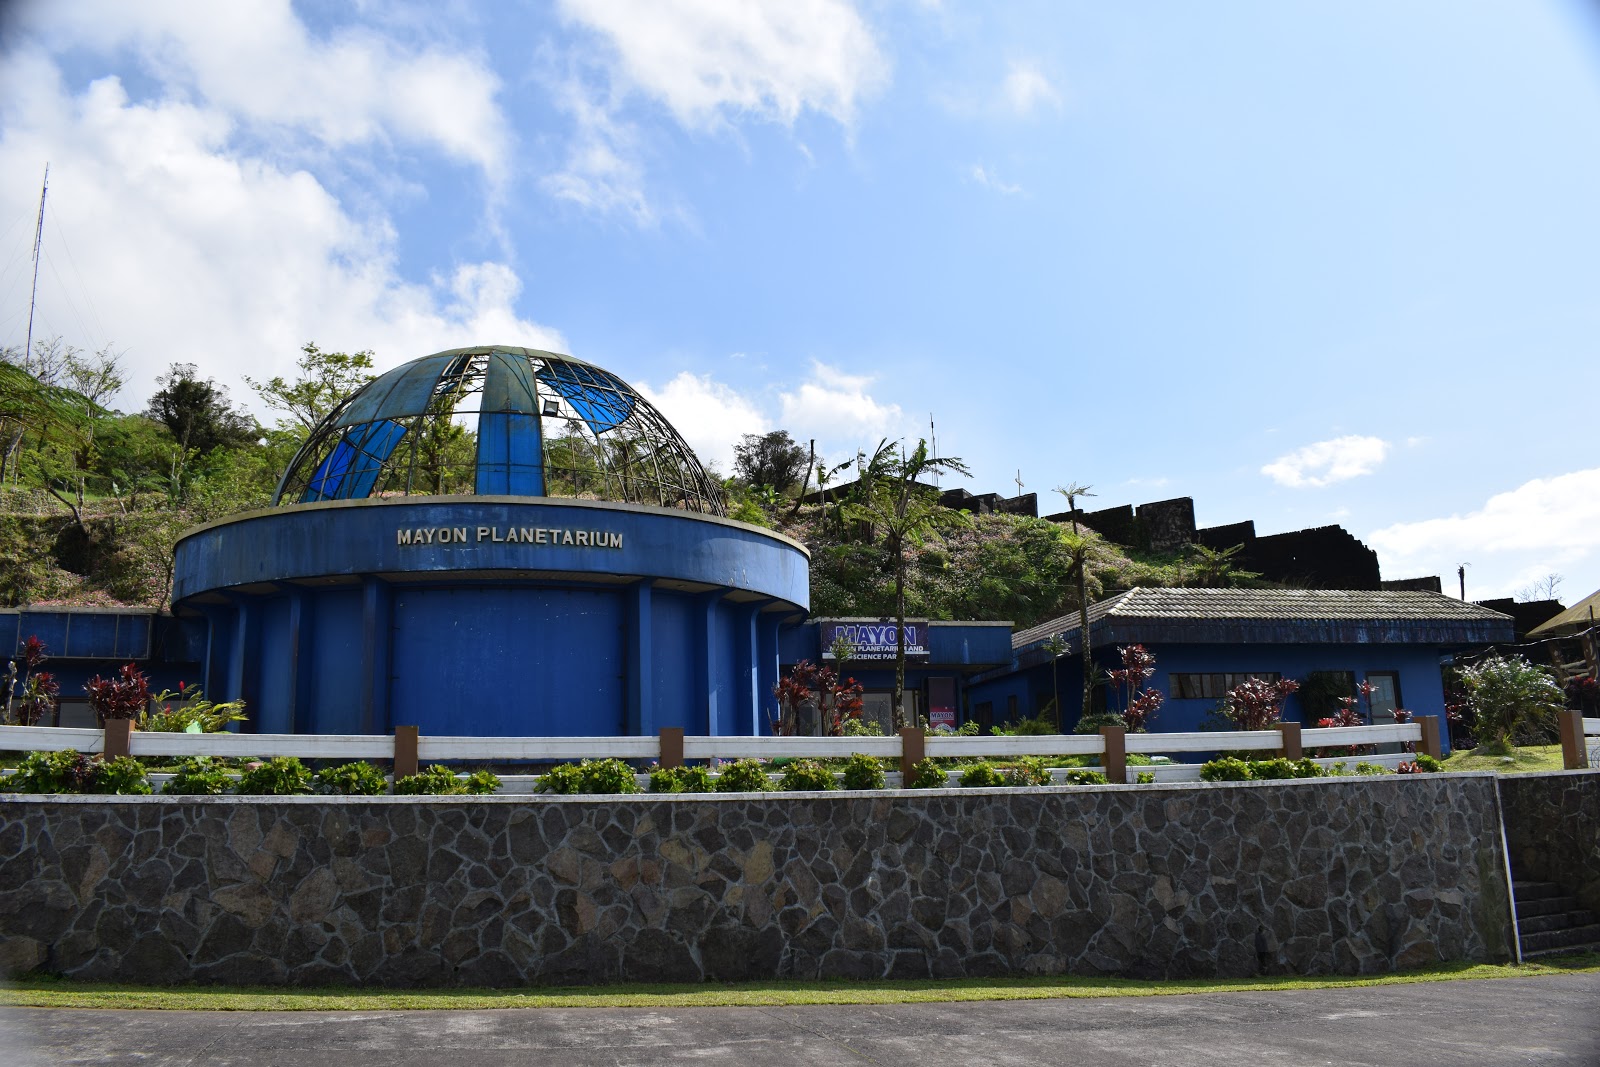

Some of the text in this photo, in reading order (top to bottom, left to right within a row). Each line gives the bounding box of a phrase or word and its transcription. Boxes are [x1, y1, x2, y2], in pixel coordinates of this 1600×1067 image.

[397, 526, 623, 549] MAYON PLANETARIUM
[835, 625, 917, 646] MAYON
[930, 711, 954, 719] MAYON
